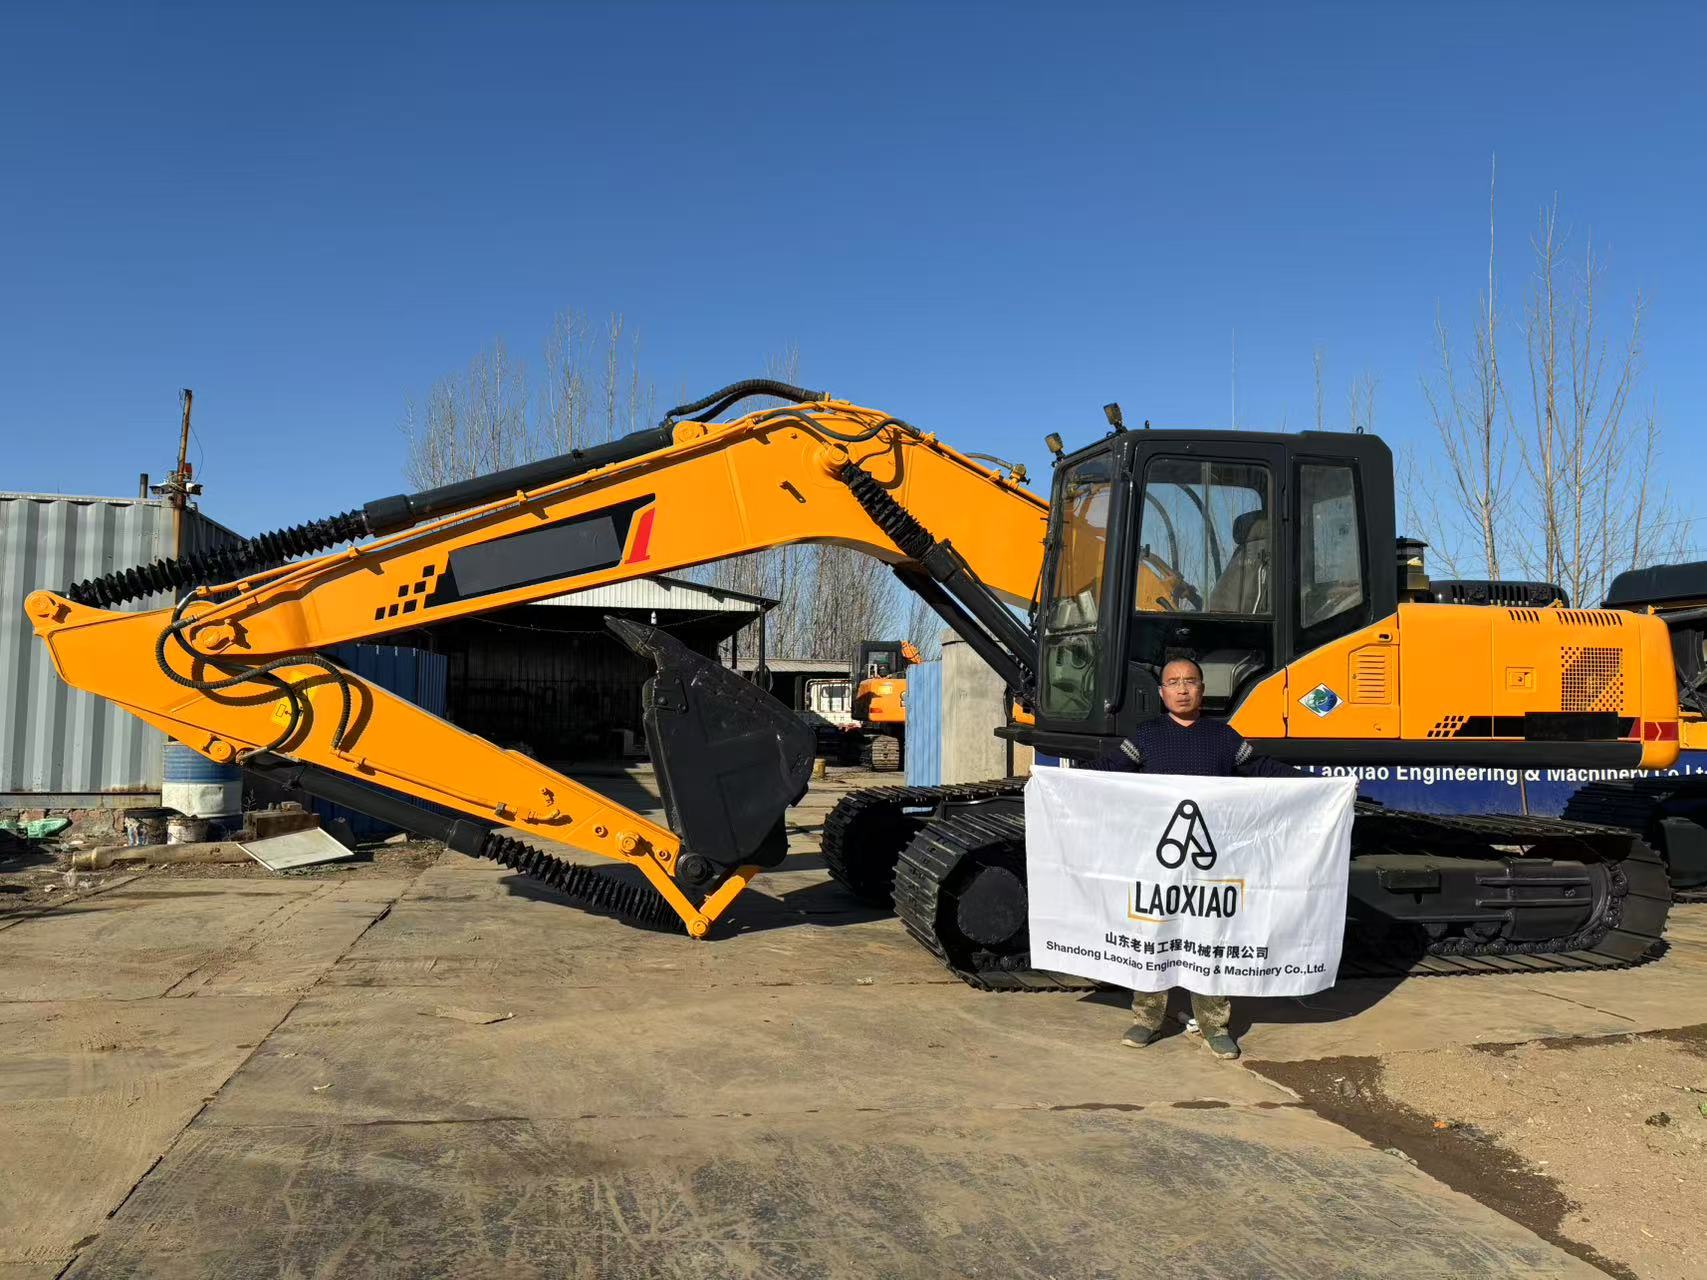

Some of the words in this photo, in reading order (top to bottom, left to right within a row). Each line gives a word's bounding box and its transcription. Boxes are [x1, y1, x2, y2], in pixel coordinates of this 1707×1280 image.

[1396, 766, 1518, 785] Engineering
[1525, 769, 1541, 782] &
[1135, 881, 1237, 918] LAOXIAO
[1046, 940, 1101, 961] Shandong
[1103, 950, 1143, 970] Laoxiao
[1146, 959, 1211, 976] Engineering
[1213, 965, 1222, 975] &
[1224, 965, 1282, 977] Machinery
[1284, 963, 1327, 975] Co.,Ltd.
[1105, 931, 1269, 960] 山东老肖工程机械有限公司
